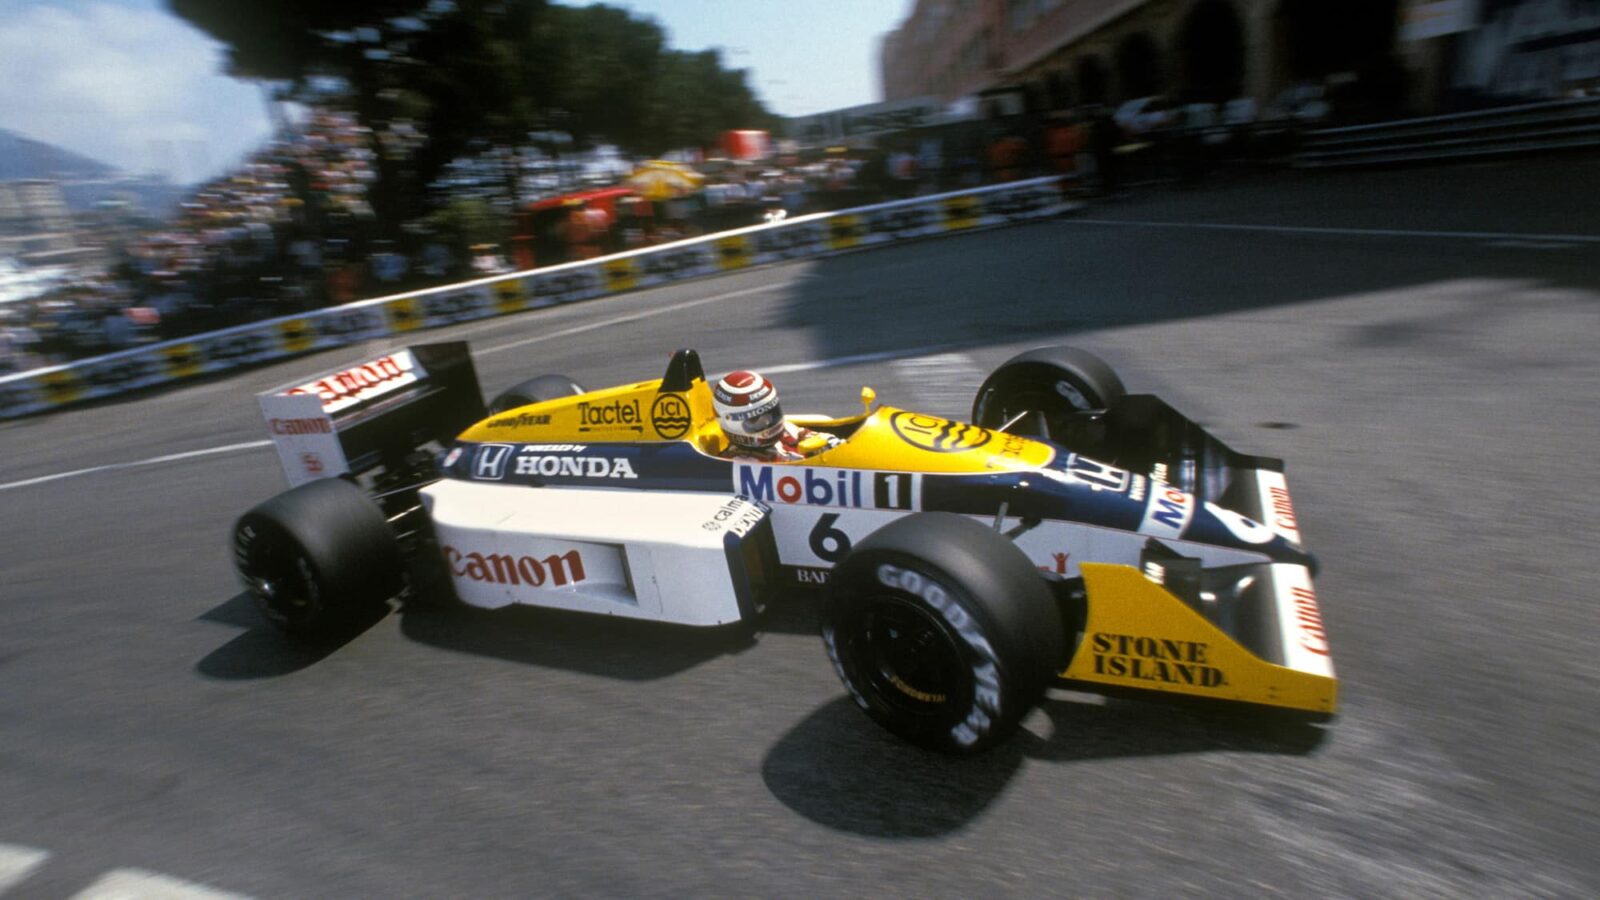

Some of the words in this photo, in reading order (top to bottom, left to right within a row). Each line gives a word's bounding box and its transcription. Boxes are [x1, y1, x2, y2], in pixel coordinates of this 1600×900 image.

[578, 399, 643, 425] Tactel
[661, 402, 680, 415] ICI
[270, 418, 332, 435] Canon
[515, 456, 638, 479] HONDA
[739, 465, 862, 507] Mobil
[884, 474, 900, 508] 1
[809, 513, 852, 563] 6
[442, 545, 586, 588] Canon
[1092, 631, 1207, 664] STONE
[1093, 654, 1223, 687] ISLAND
